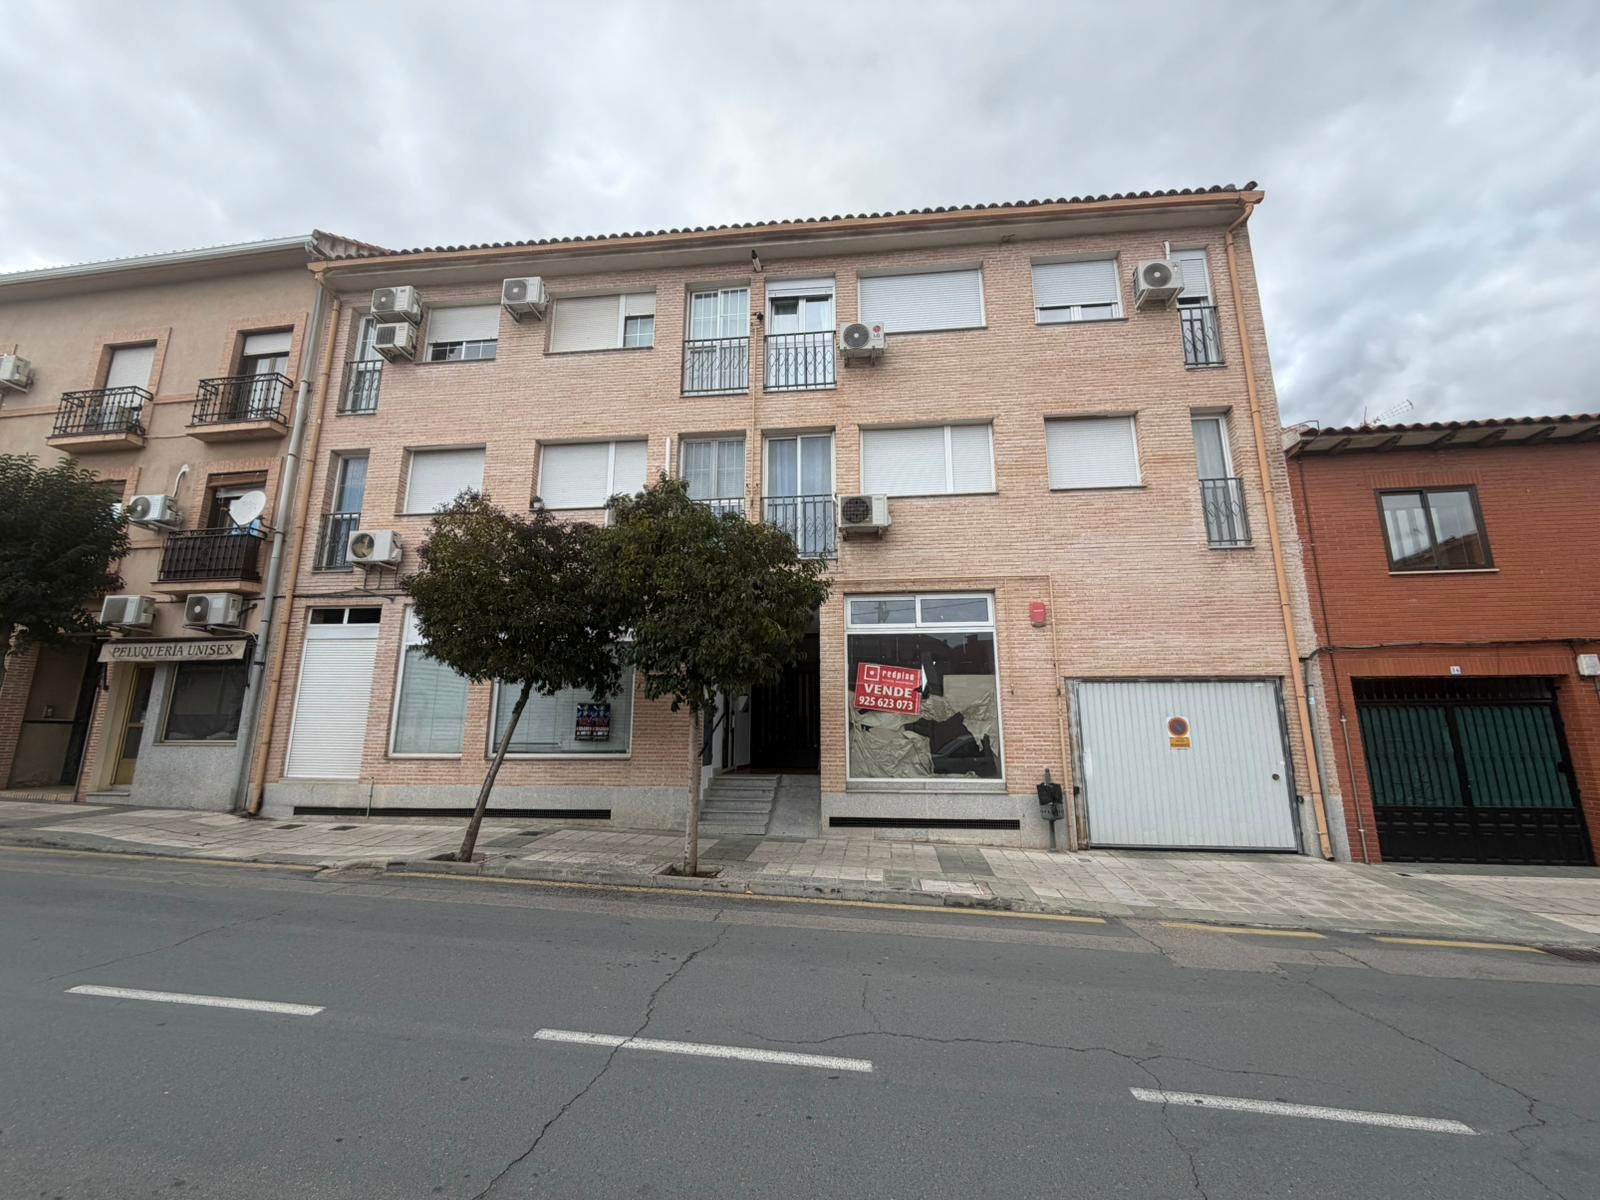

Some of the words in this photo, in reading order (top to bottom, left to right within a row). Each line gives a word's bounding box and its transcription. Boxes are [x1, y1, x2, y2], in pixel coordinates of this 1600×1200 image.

[187, 643, 233, 656] UNISEX
[864, 683, 912, 698] VENDE
[859, 696, 876, 706] 925
[877, 698, 894, 708] 623
[896, 700, 913, 711] 073
